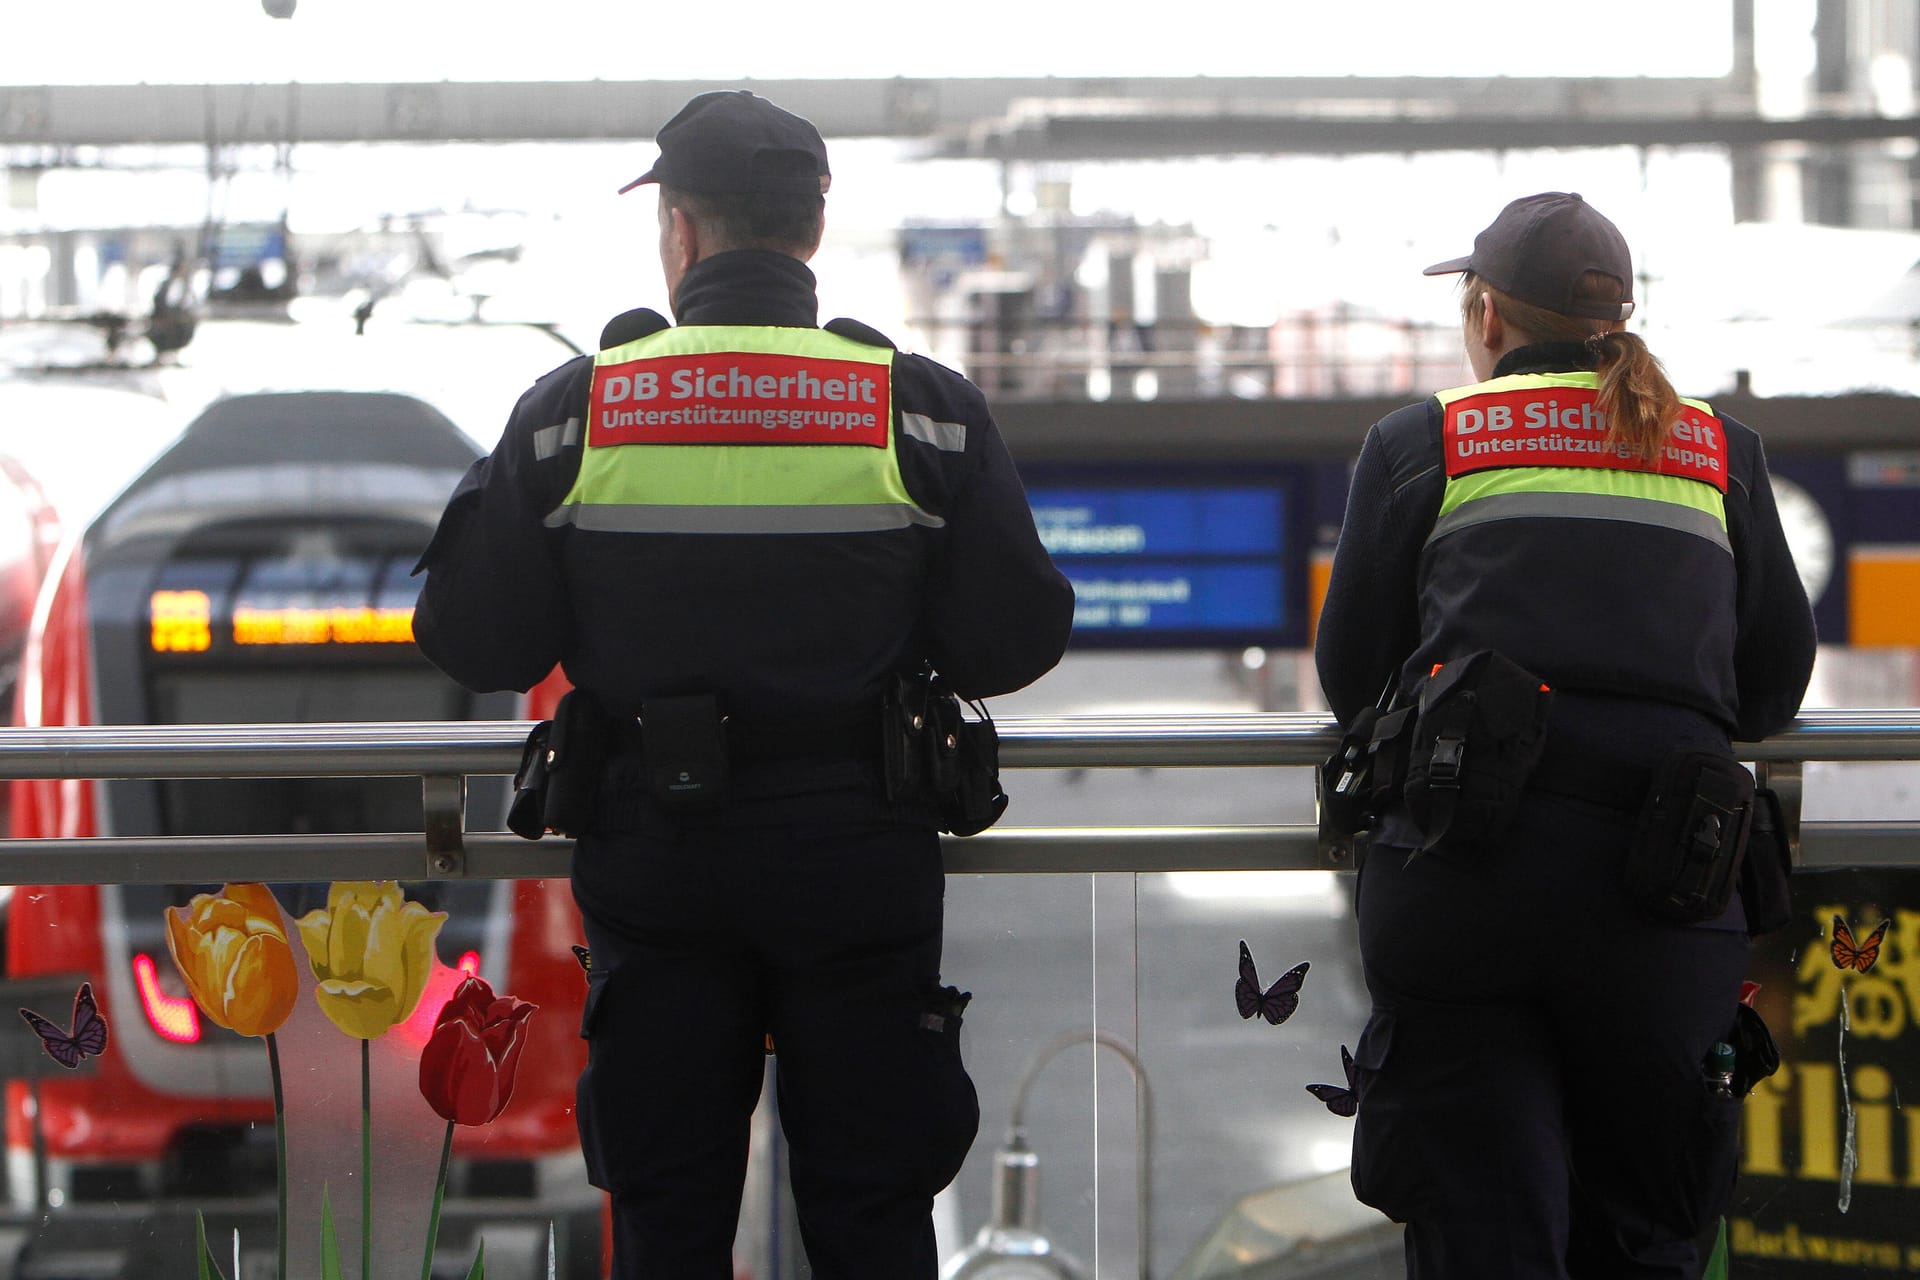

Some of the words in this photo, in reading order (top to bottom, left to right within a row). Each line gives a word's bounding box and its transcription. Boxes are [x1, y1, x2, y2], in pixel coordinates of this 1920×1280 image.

[603, 372, 659, 404] DB
[670, 367, 877, 403] Sicherheit
[602, 404, 876, 430] Unterstützungsgruppe
[1456, 405, 1513, 435] DB
[1524, 400, 1718, 450] Sicheit
